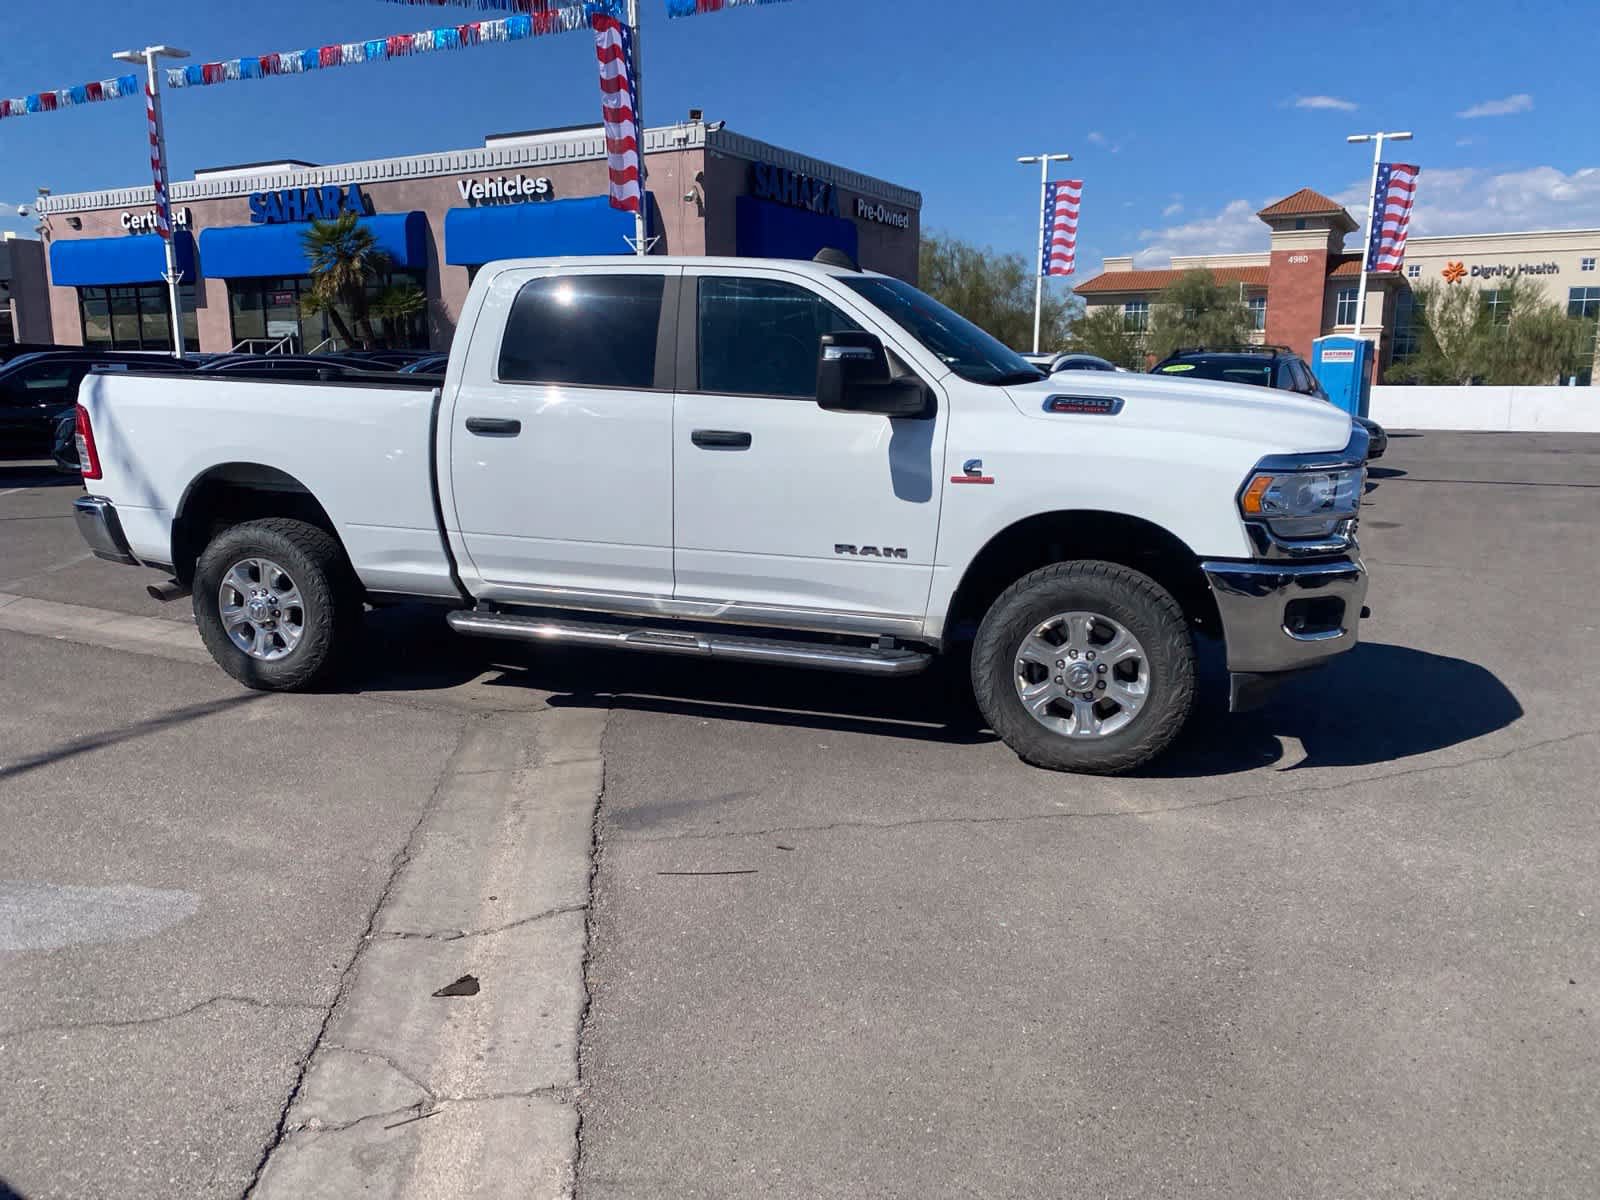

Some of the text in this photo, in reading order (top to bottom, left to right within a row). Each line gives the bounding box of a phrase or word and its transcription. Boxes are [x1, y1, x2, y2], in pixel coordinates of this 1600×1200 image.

[457, 174, 548, 200] Vehicles
[249, 183, 366, 223] SAHARA
[857, 198, 909, 229] Pre-Owned
[120, 206, 187, 229] Certied
[1470, 261, 1560, 279] Dignity Health
[834, 543, 908, 560] RAM
